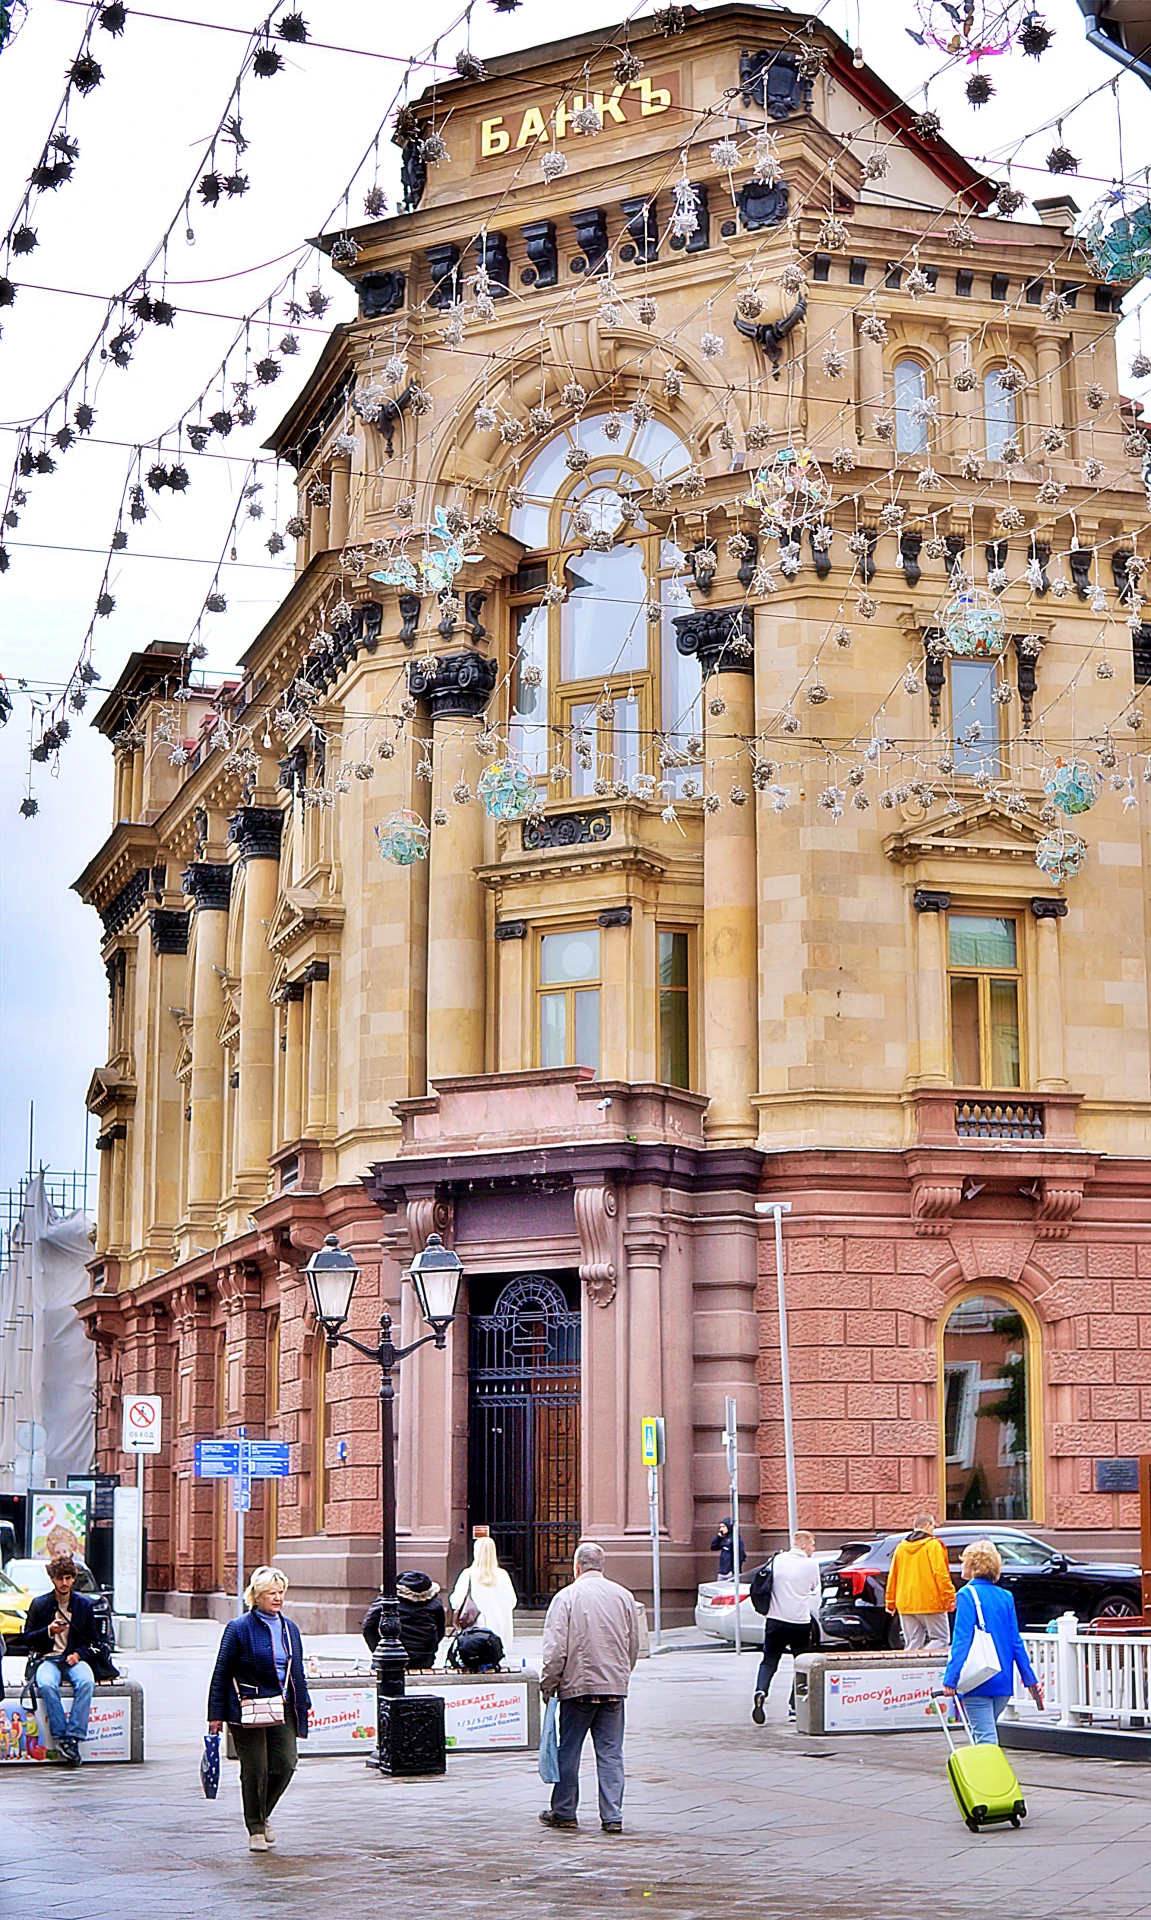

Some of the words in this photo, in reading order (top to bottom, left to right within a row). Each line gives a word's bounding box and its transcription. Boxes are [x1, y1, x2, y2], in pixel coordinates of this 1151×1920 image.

[481, 77, 671, 157] БАНКЪ
[445, 1693, 496, 1710] ПОБЕЖДАЕТ
[480, 1696, 521, 1711] КАЖДЫЙ!
[842, 1686, 892, 1705] Голосуй
[883, 1686, 933, 1705] онлайн!
[88, 1709, 124, 1723] АЖДЫЙ!
[308, 1709, 360, 1728] онлайн!
[498, 1717, 520, 1726] баллов
